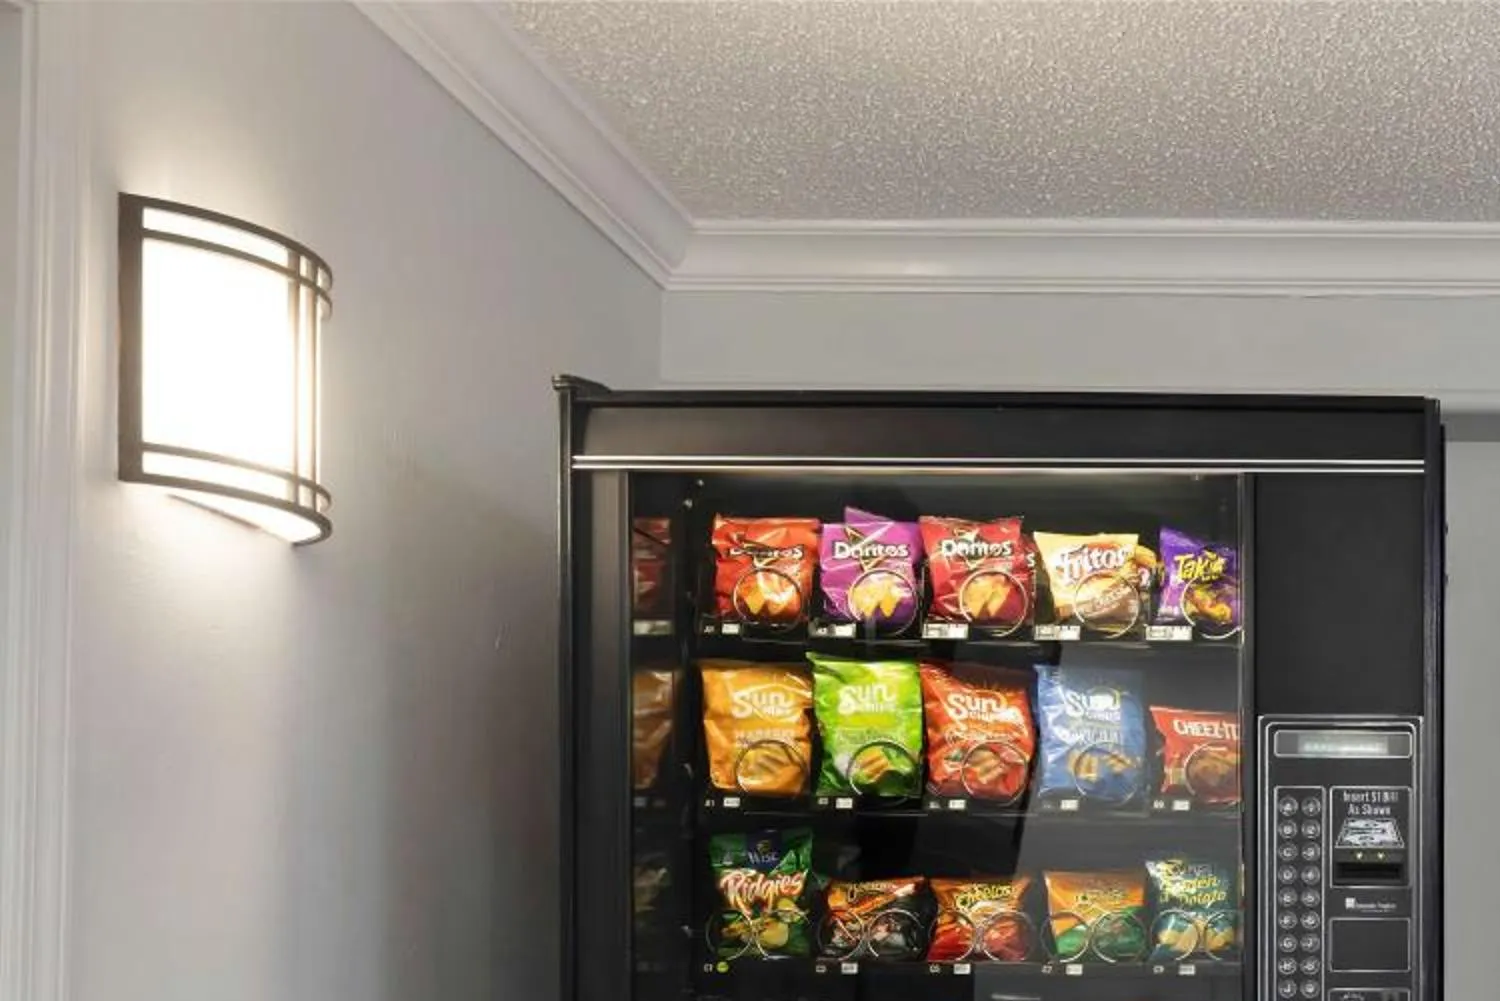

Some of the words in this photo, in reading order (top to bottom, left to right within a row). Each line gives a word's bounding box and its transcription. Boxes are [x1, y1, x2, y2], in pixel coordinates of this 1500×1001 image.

[833, 540, 910, 560] Doritos
[730, 689, 796, 720] Sun
[837, 683, 897, 716] Sun
[946, 692, 1003, 722] Sun
[1064, 690, 1121, 718] Sun
[719, 869, 808, 905] Ridgies
